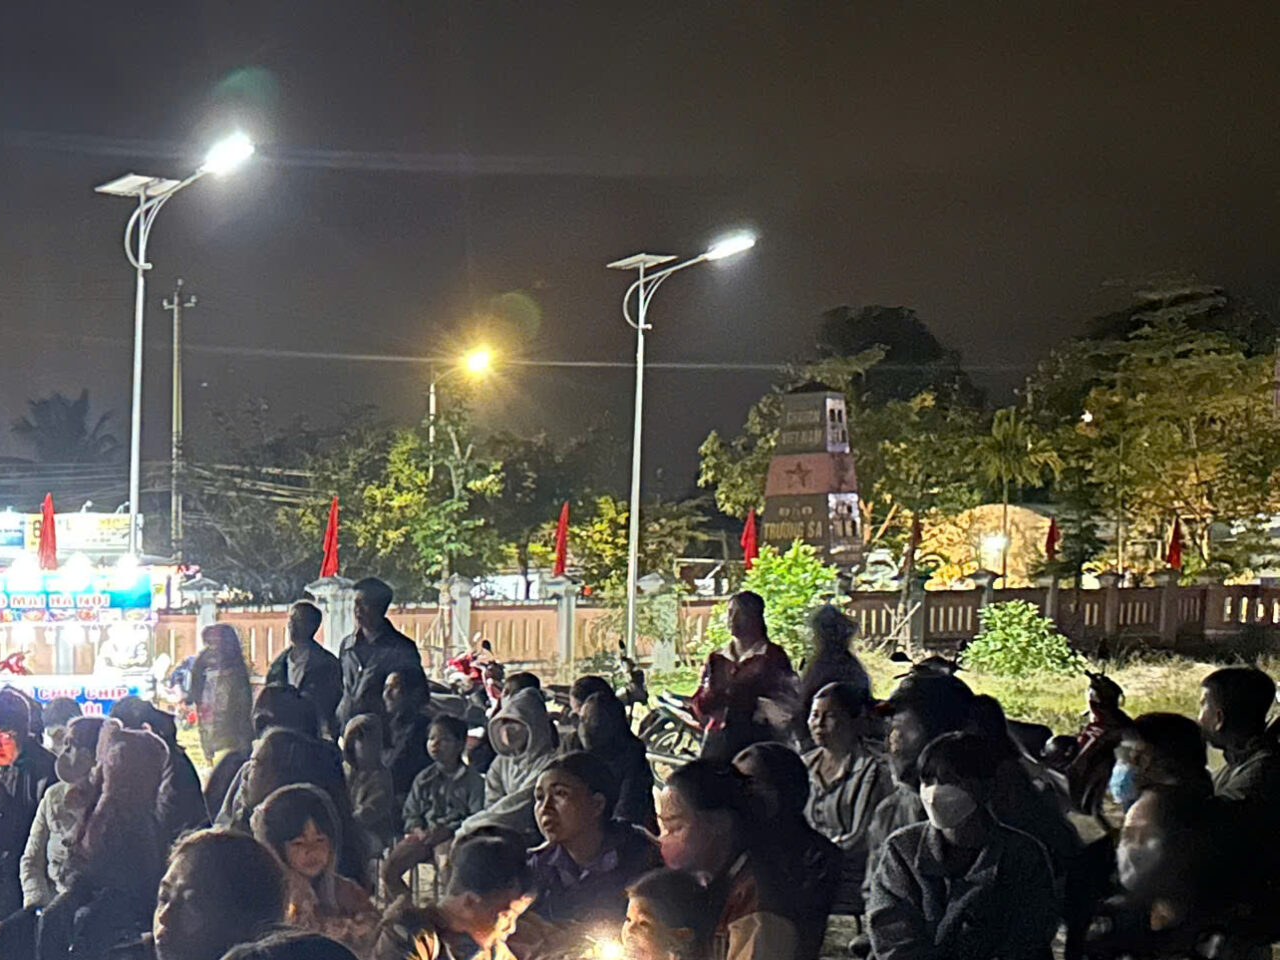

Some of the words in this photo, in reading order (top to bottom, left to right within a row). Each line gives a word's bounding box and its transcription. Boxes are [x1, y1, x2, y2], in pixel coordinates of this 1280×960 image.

[807, 520, 823, 539] SA
[39, 688, 80, 700] CHIP
[86, 688, 128, 700] CHIP
